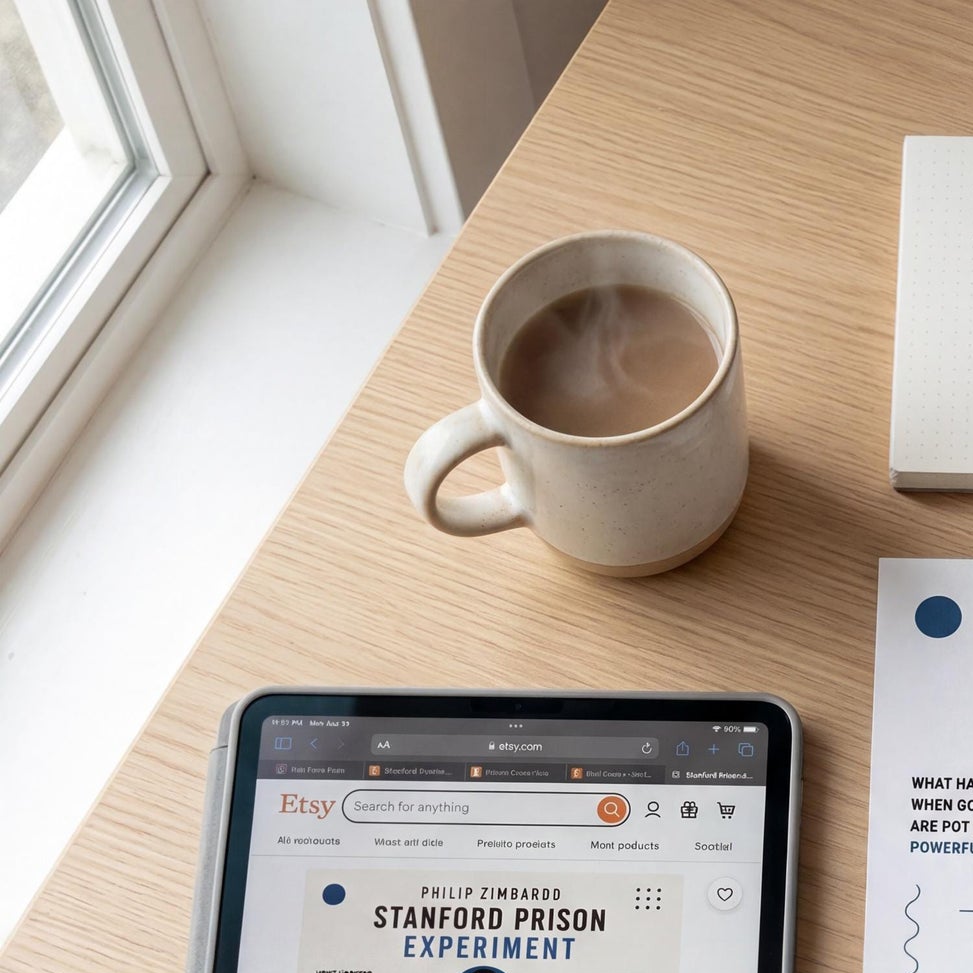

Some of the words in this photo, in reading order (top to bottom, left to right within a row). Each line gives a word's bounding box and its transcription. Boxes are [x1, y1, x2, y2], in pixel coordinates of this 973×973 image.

[499, 742, 543, 752] etsy.com
[912, 777, 953, 789] WHAT
[279, 794, 336, 819] Etsy
[354, 801, 395, 812] Search
[398, 801, 415, 812] for
[418, 802, 469, 815] anything
[911, 799, 953, 811] WHEN
[910, 820, 938, 832] ARE
[942, 821, 970, 832] POT
[421, 887, 473, 899] PHILIP
[374, 906, 503, 930] STANFORD
[515, 908, 606, 931] PRISON
[404, 936, 575, 959] EXPERIMENT
